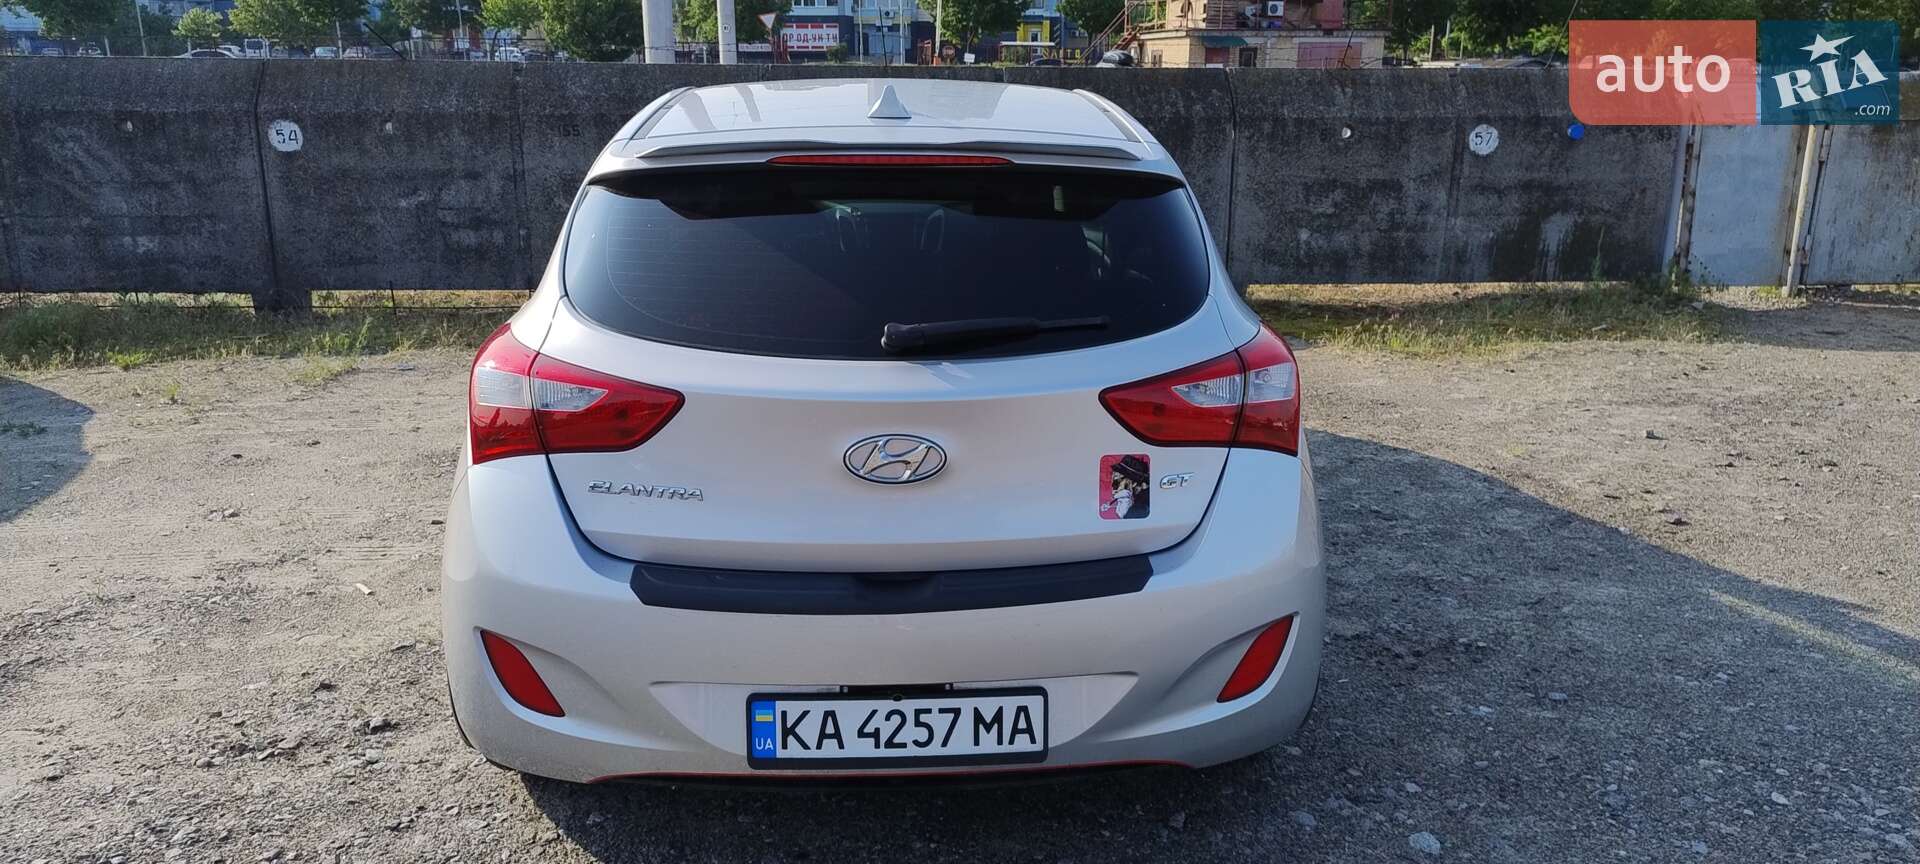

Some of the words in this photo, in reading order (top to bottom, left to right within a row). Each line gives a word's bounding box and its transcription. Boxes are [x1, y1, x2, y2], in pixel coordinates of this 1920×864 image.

[275, 128, 299, 145] 54
[1475, 131, 1493, 146] 57
[1159, 471, 1195, 490] GT
[587, 480, 704, 502] ELANTRA
[780, 709, 845, 750] KA
[856, 707, 962, 750] 4257
[972, 705, 1037, 747] MA
[755, 736, 773, 750] UA
